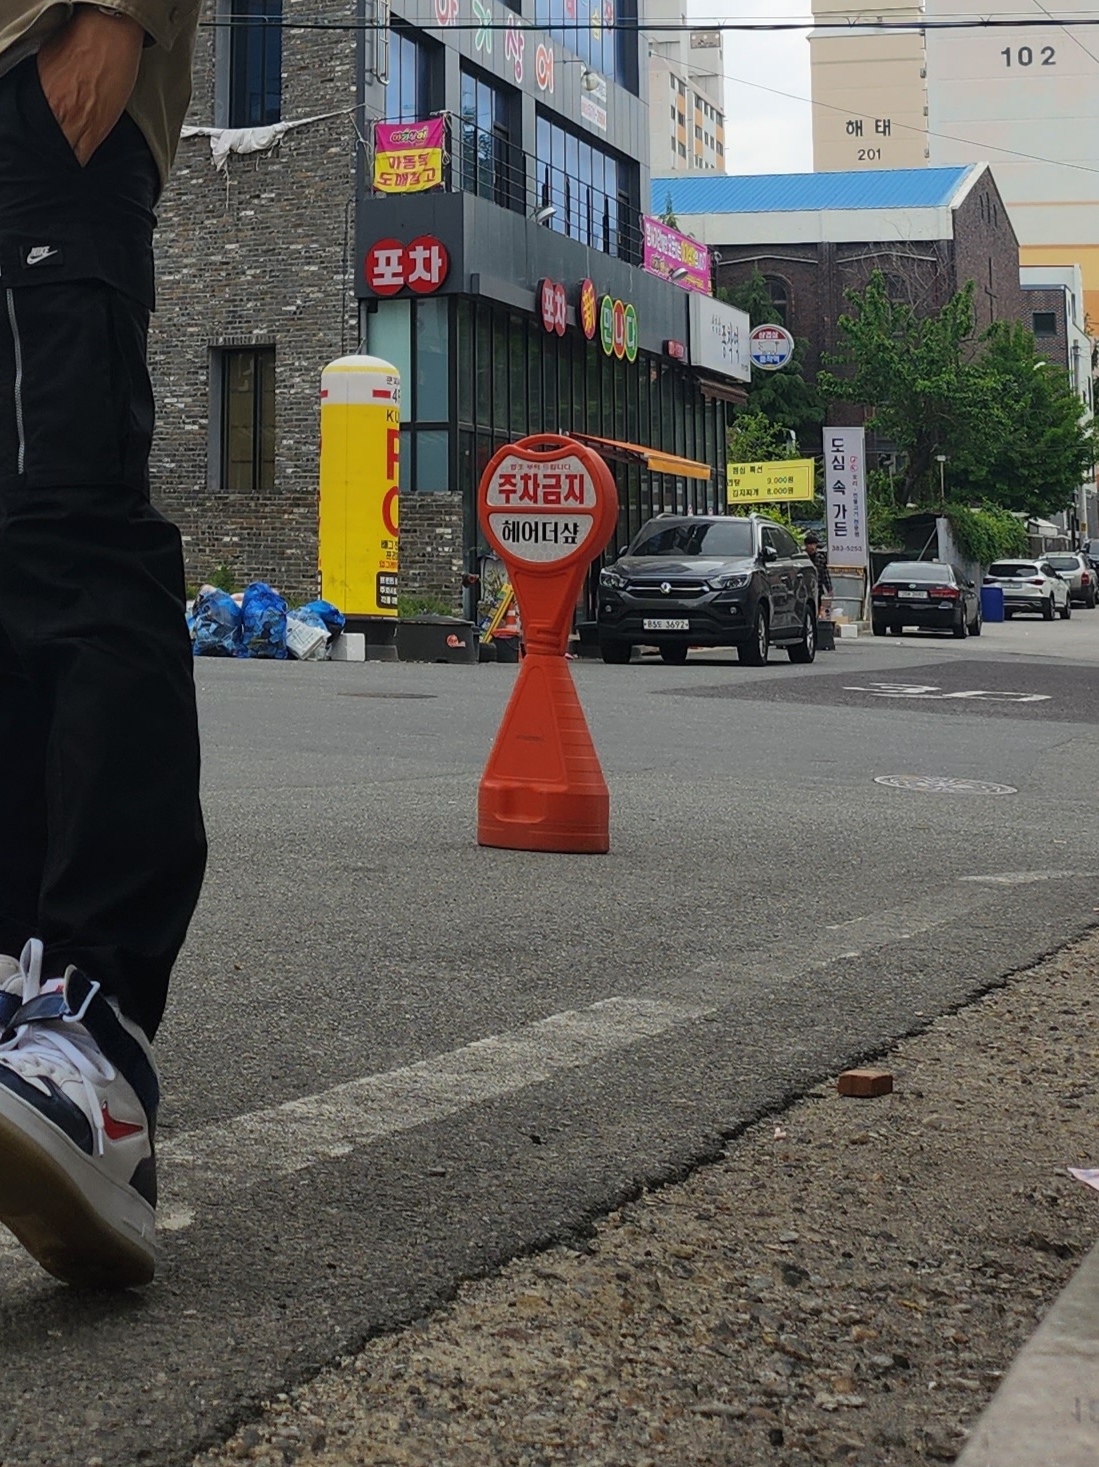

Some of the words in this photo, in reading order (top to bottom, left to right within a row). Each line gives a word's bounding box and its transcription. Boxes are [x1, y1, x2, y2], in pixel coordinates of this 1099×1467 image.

[1001, 45, 1057, 67] 102
[845, 118, 892, 138] 해태
[857, 148, 882, 161] 201
[372, 245, 442, 286] 포차
[543, 287, 566, 329] 포차
[831, 437, 845, 471] 도심
[498, 473, 585, 505] 주차금지
[832, 479, 846, 496] 속
[833, 503, 848, 537] 가든
